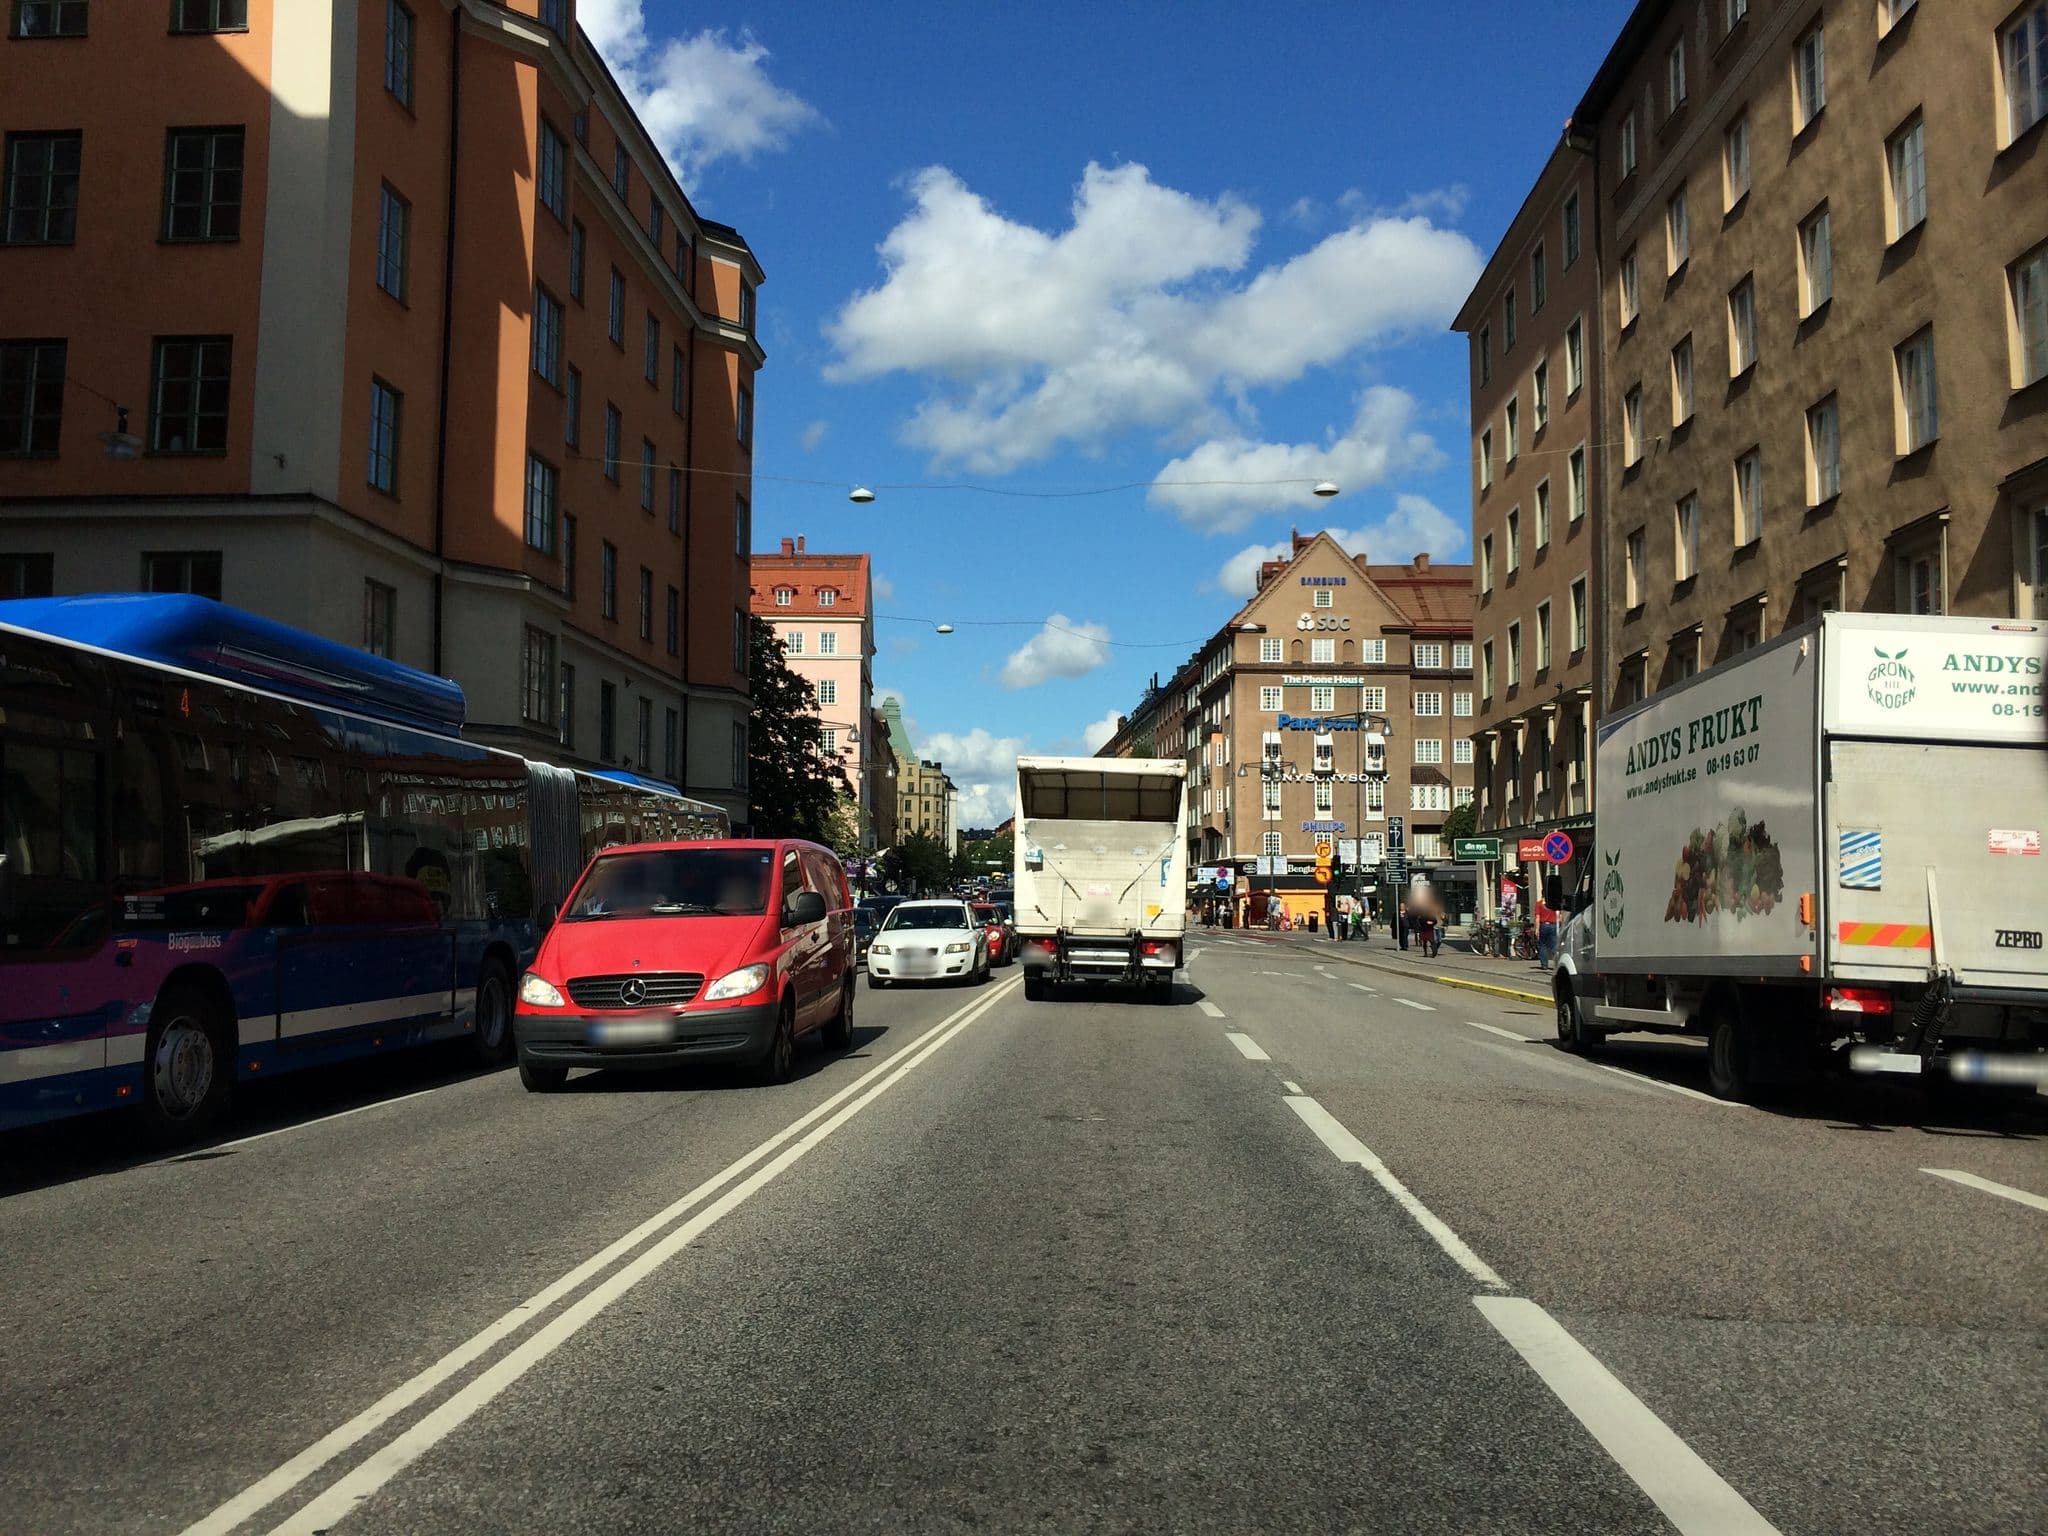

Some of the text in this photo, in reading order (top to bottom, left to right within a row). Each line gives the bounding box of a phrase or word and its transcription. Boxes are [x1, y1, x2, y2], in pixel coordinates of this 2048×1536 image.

[1942, 653, 2042, 675] ANDYS
[1282, 675, 1301, 684] The
[1302, 675, 1333, 684] Phone
[1626, 695, 1762, 776] ANDYS FRUKT
[1706, 756, 1731, 776] 08-19
[1733, 751, 1745, 768] 63
[1747, 744, 1760, 763] 07
[1261, 773, 1302, 783] SNY
[1994, 929, 2043, 949] ZEPRO
